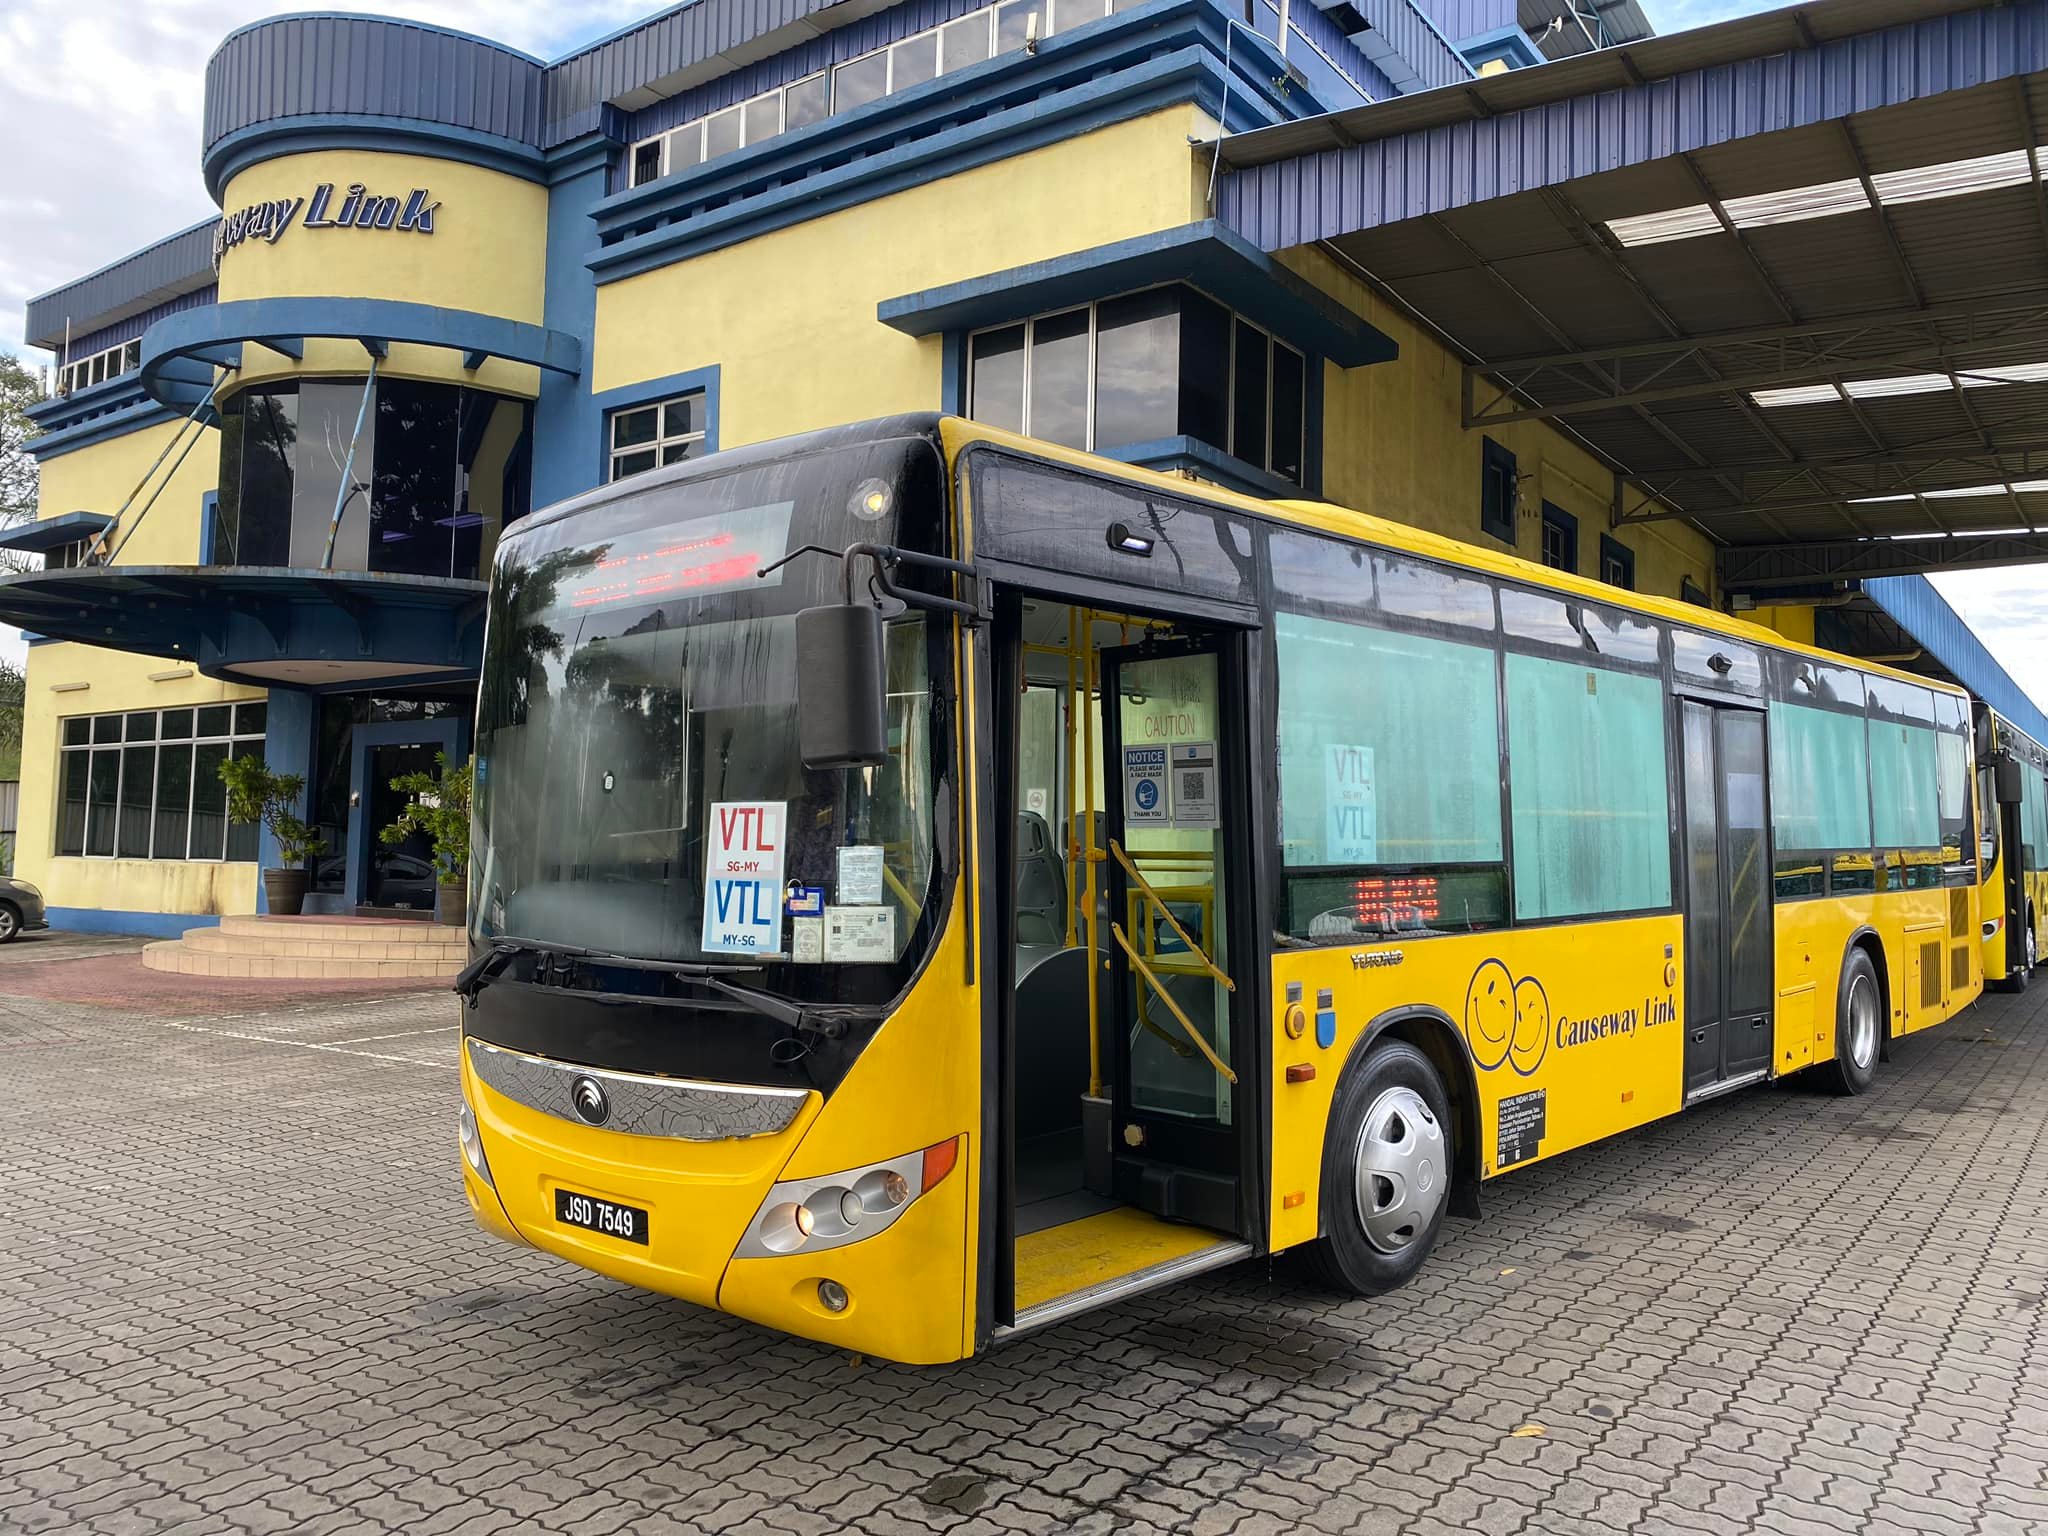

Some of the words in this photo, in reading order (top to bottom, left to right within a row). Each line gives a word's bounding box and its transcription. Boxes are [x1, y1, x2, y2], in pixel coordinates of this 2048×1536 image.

[303, 182, 441, 234] Link
[1144, 713, 1195, 737] CAUTION
[1128, 751, 1163, 764] NOTICE
[720, 807, 774, 851] VTL
[1335, 806, 1371, 840] VTL
[727, 861, 759, 872] SG-MY
[715, 880, 771, 925] VTL
[722, 934, 756, 946] MY-SG
[1350, 949, 1404, 970] YUTONG
[1556, 1007, 1639, 1049] Causeway
[1644, 993, 1676, 1028] Link
[565, 1196, 591, 1225] JSD
[596, 1202, 633, 1236] 7549
